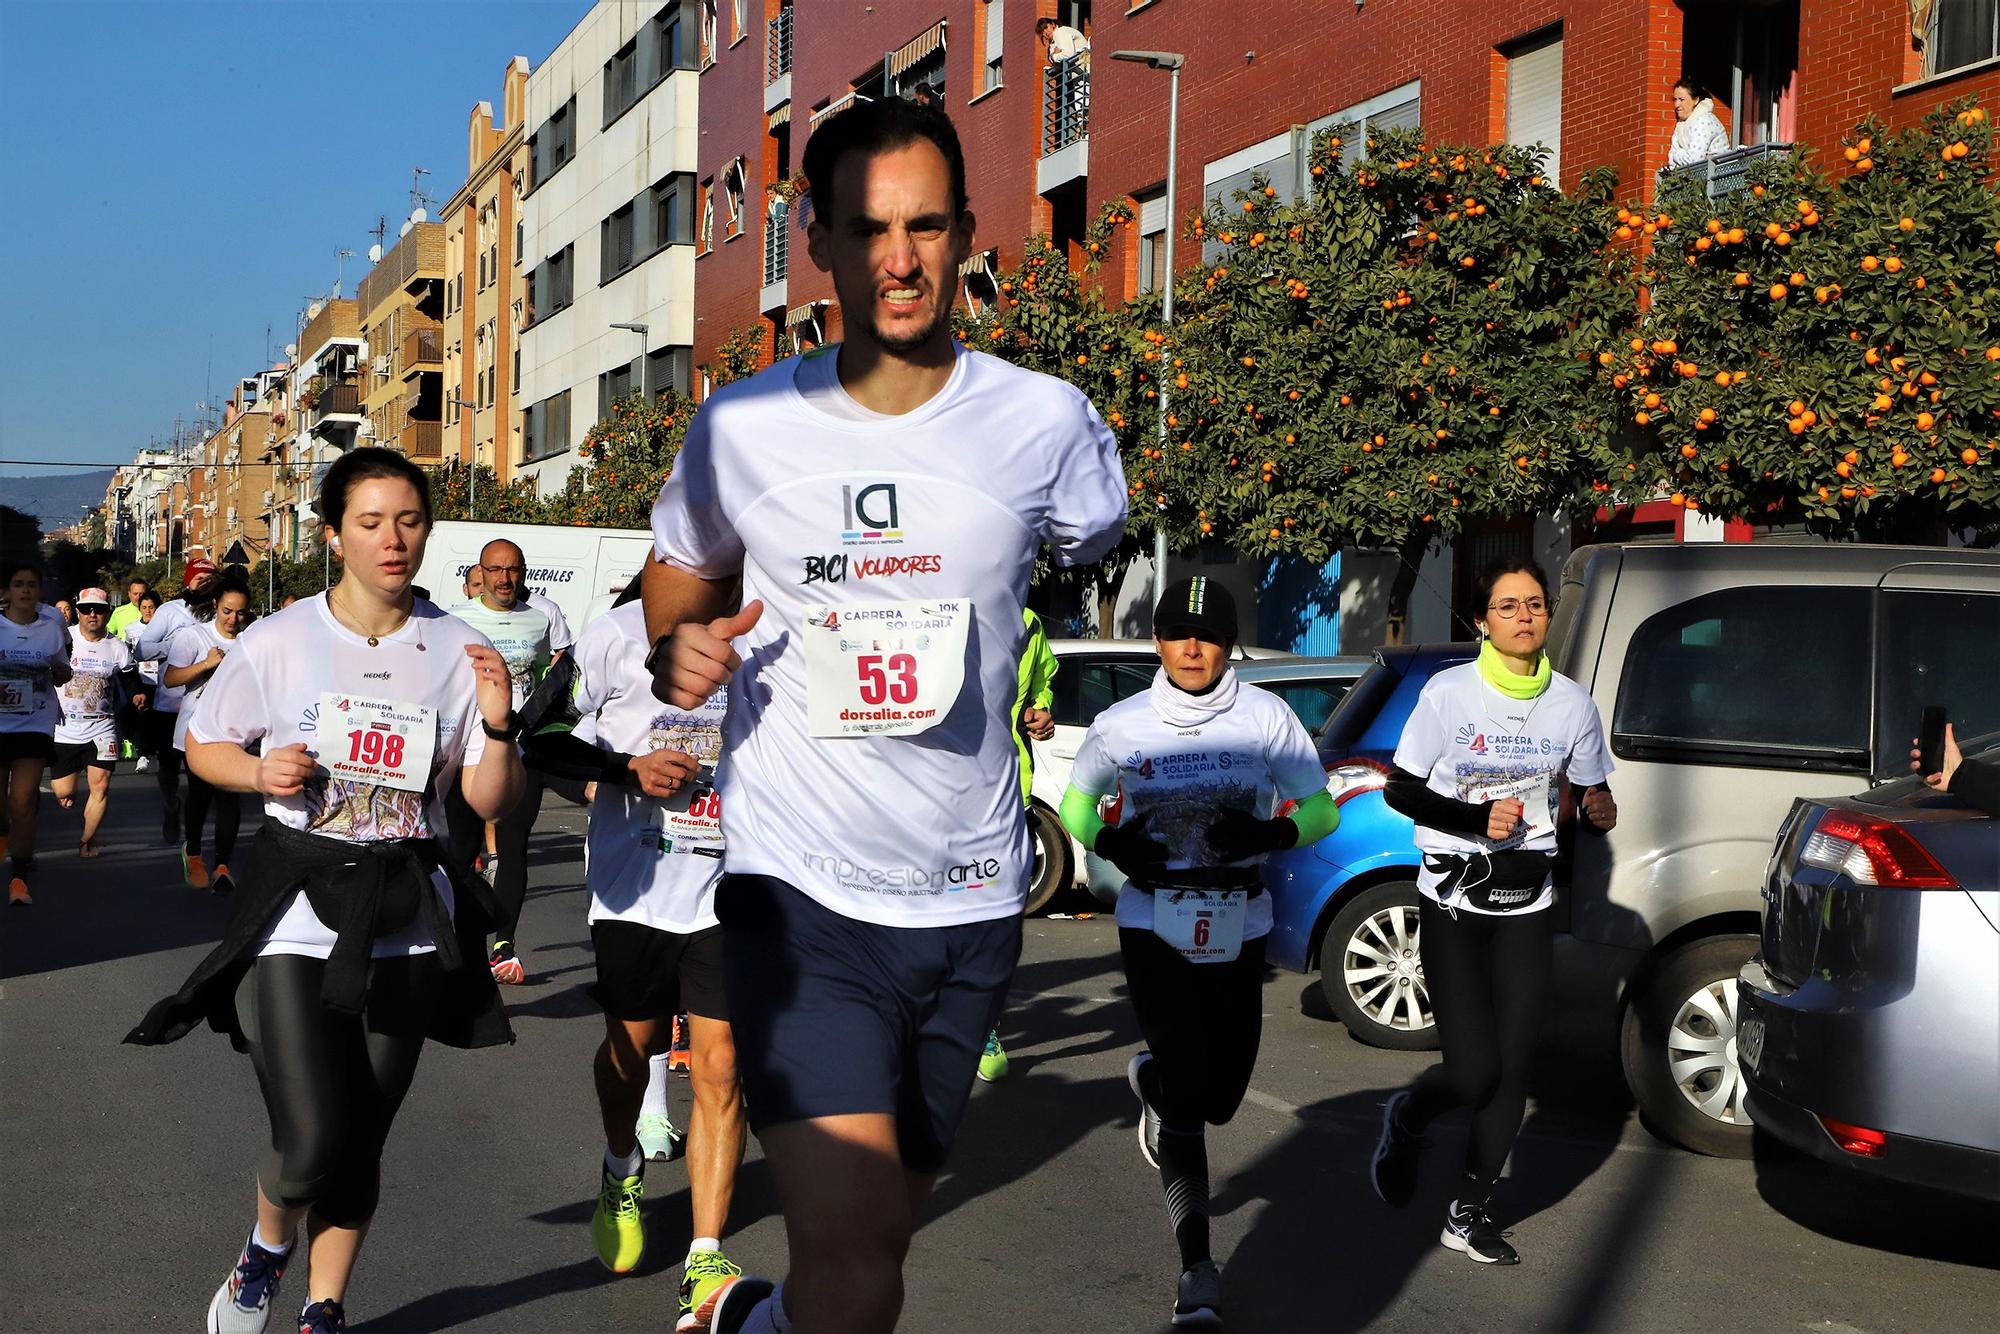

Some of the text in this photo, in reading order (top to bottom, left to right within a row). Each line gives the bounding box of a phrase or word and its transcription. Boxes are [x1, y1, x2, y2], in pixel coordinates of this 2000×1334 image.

[526, 568, 574, 582] NERALES
[798, 553, 942, 584] BICI VOLADORES
[939, 603, 960, 612] 10K
[844, 610, 903, 621] CARRERA
[858, 654, 918, 705] 53
[354, 700, 393, 712] CARRERA
[380, 712, 424, 724] SOLIDARIA
[840, 706, 936, 721] dorsalia.com
[1487, 736, 1532, 745] CARRERA
[348, 729, 405, 768] 198
[1154, 753, 1208, 766] CARRERA
[334, 762, 406, 780] dorsalia.com
[1162, 763, 1216, 774] SOLIDARIA
[688, 789, 720, 820] 68
[671, 815, 720, 828] dorsalia.c
[1195, 919, 1210, 946] 6
